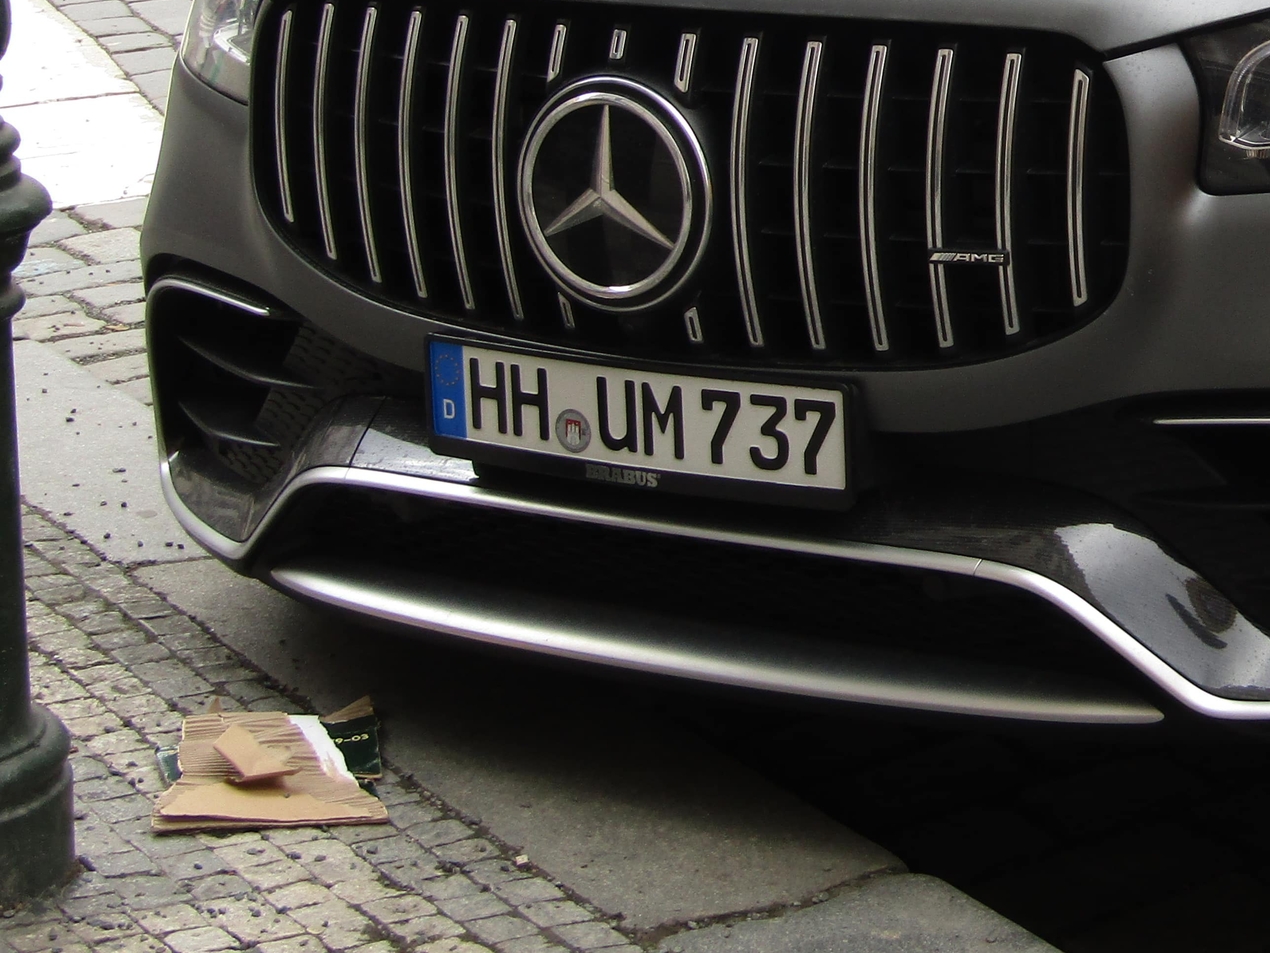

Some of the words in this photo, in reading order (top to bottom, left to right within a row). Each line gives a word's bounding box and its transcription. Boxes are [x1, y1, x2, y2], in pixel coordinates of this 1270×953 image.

[952, 252, 1005, 264] AMG
[443, 398, 456, 420] D
[469, 357, 551, 442] HH
[596, 375, 685, 461] UM
[701, 388, 837, 476] 737
